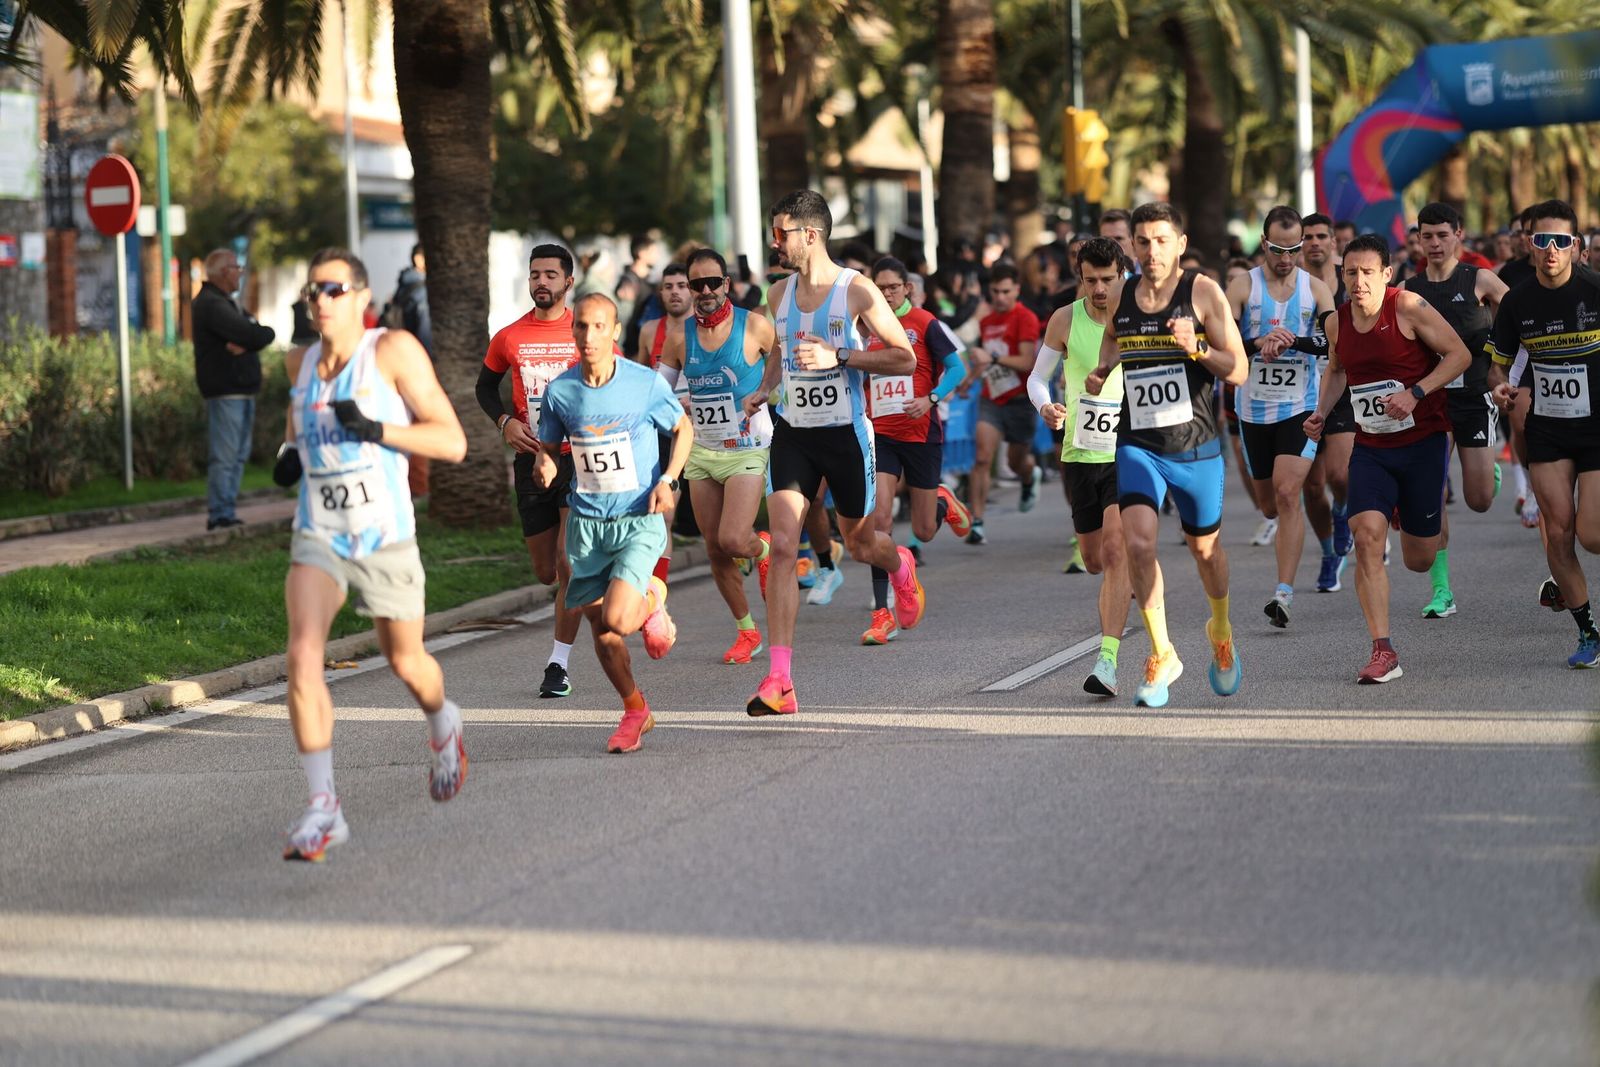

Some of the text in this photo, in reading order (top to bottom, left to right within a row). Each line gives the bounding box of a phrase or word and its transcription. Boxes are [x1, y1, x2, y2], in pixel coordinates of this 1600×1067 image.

[1258, 367, 1297, 387] 152
[1540, 377, 1581, 399] 340
[795, 385, 838, 407] 369
[876, 381, 907, 401] 144
[1134, 381, 1181, 407] 200
[695, 406, 731, 425] 321
[1358, 393, 1395, 418] 26
[580, 450, 625, 473] 151
[320, 482, 374, 510] 821
